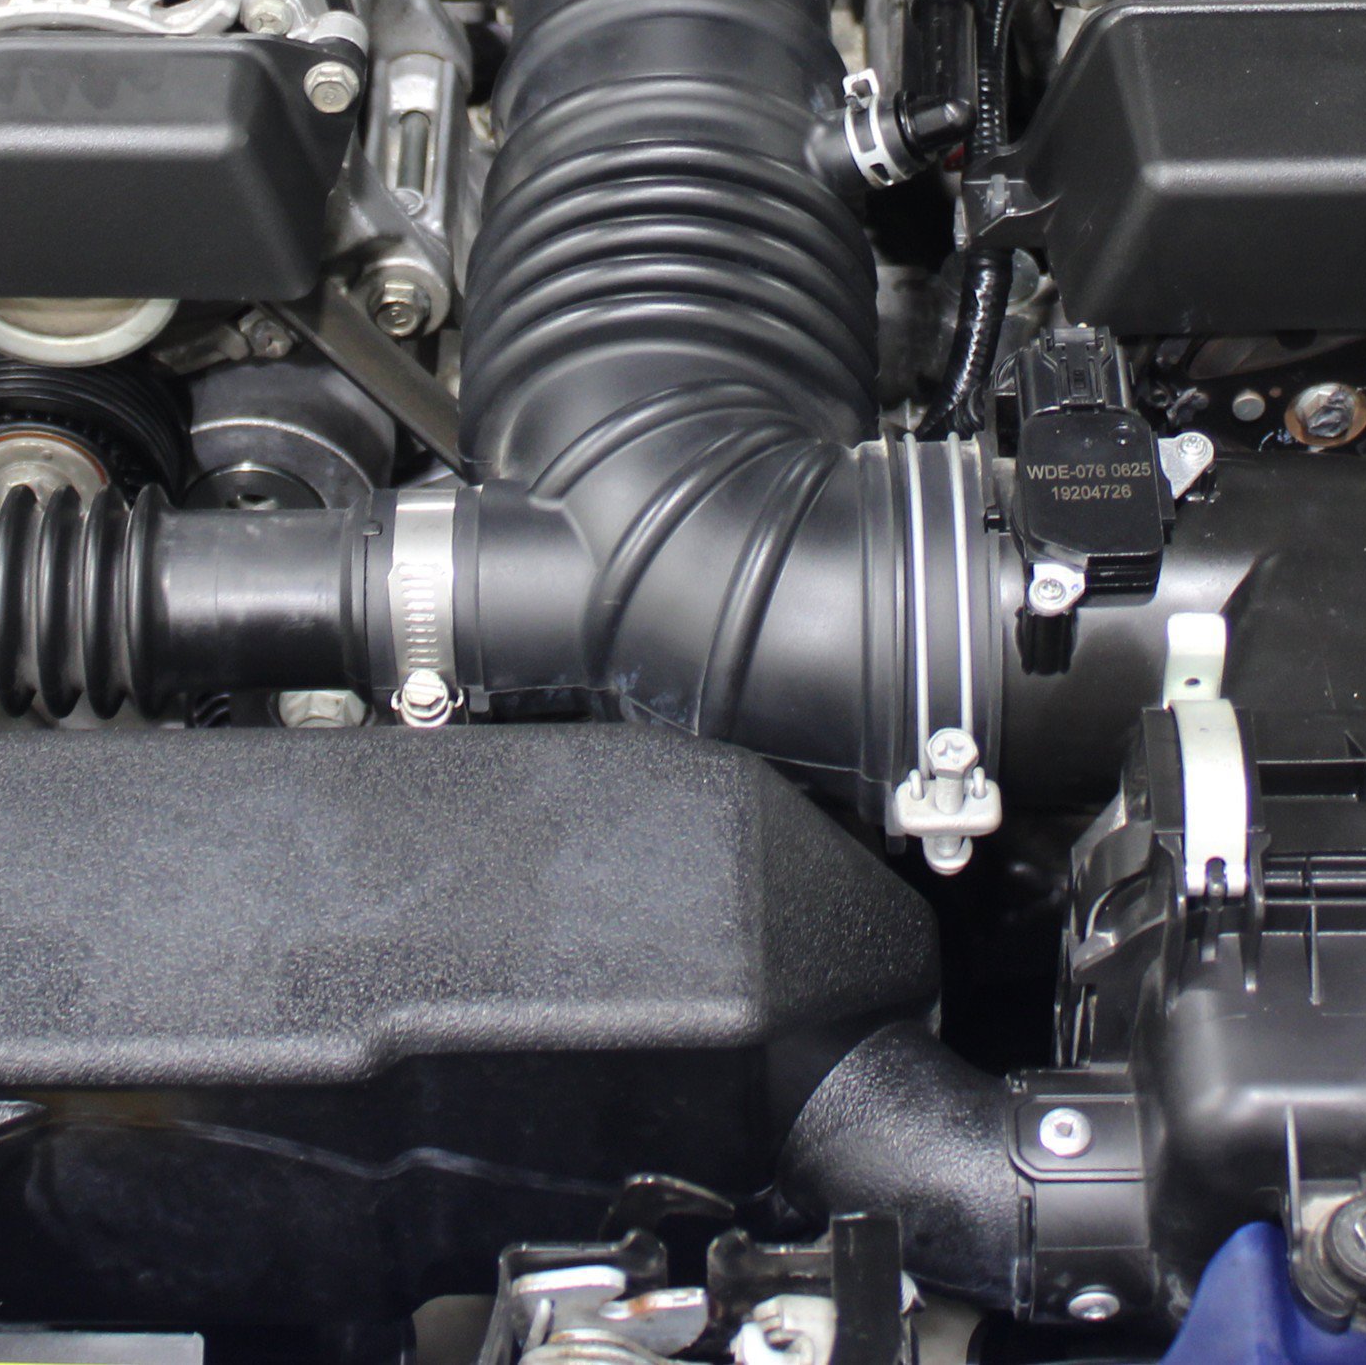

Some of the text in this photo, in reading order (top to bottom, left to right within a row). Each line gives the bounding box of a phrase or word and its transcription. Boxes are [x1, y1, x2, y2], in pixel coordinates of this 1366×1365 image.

[1026, 462, 1152, 480] WDE-076 0625
[1051, 484, 1133, 501] 19204726
